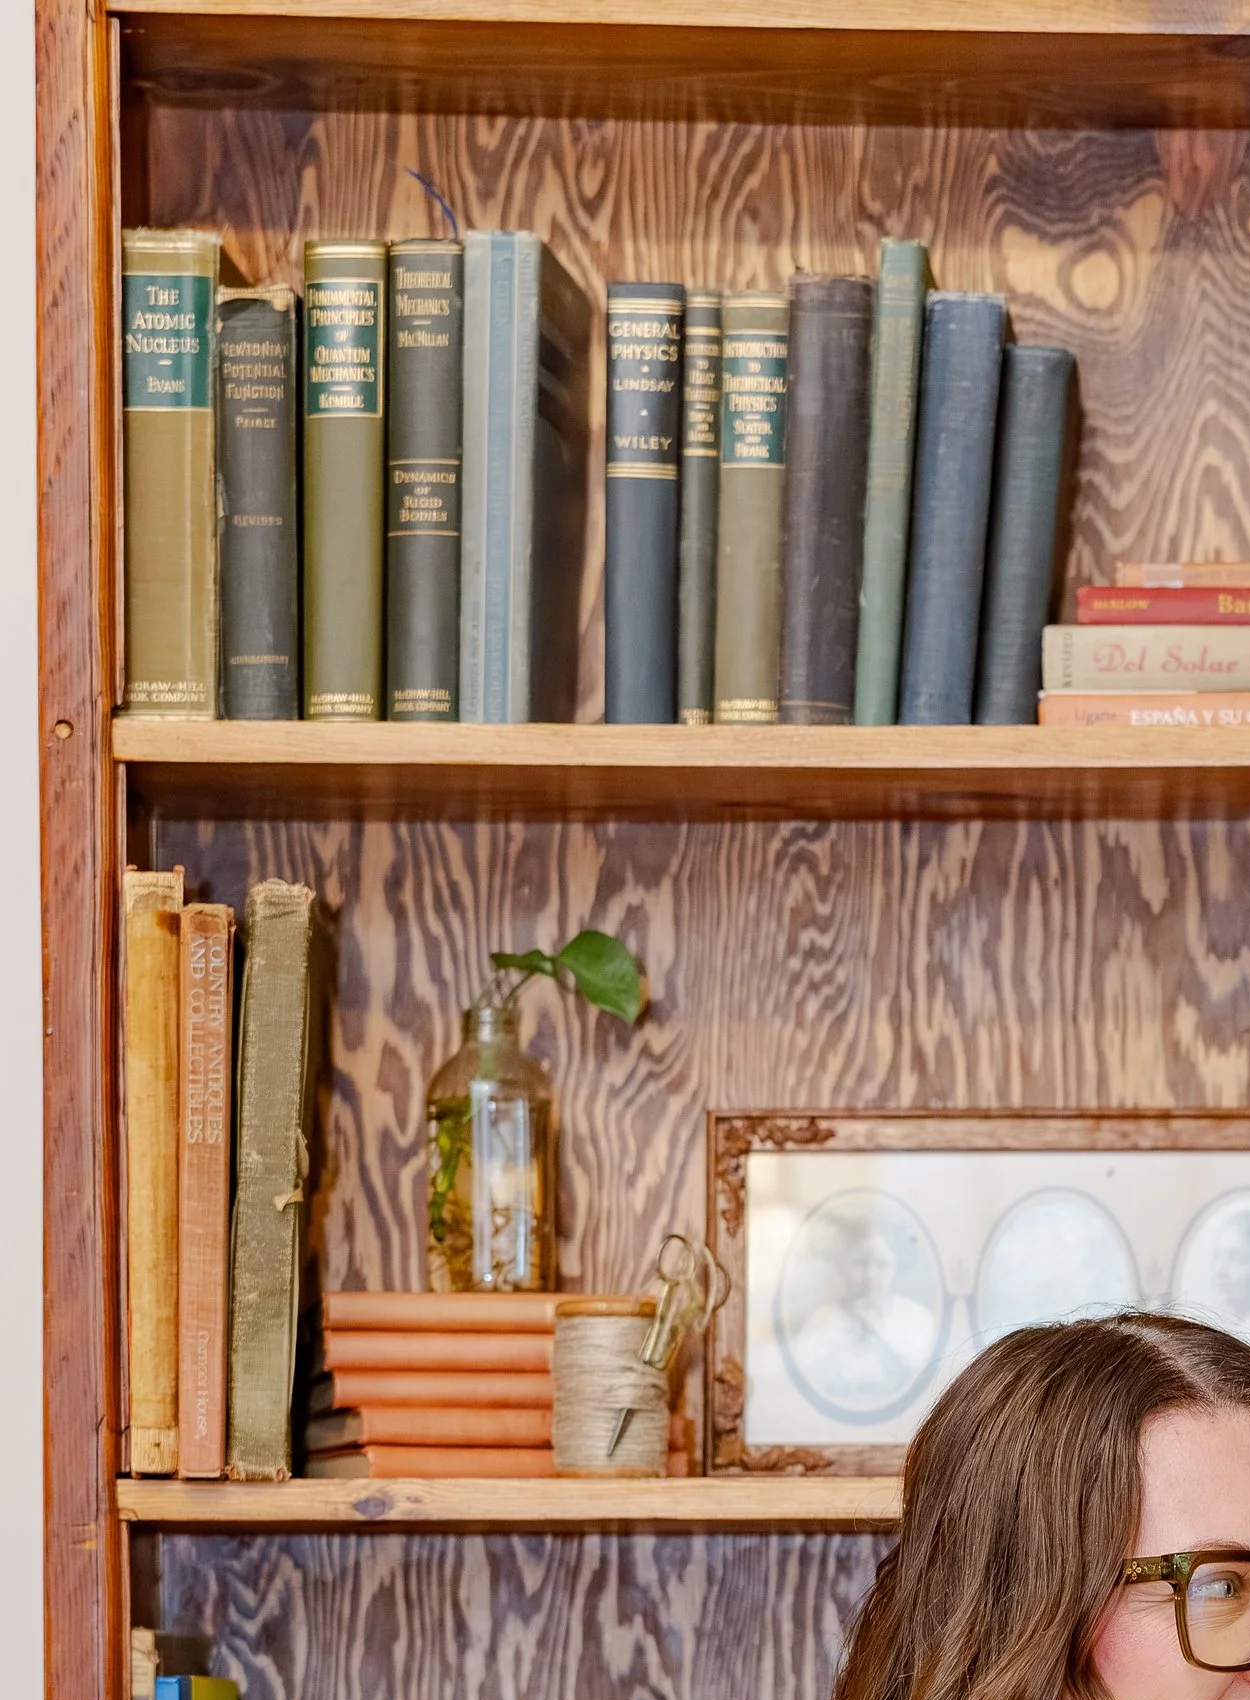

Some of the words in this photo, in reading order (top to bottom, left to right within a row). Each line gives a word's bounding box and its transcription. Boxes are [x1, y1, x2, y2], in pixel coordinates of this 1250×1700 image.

[145, 285, 180, 306] THE
[395, 294, 450, 316] MECHANICS
[131, 311, 195, 330] ATOMIC
[310, 309, 375, 327] PRINCIPLES
[608, 320, 681, 340] GENERAL
[125, 333, 200, 354] NUCLEUS
[611, 343, 679, 361] PHYSICS
[314, 345, 371, 365] QUANTUM
[223, 362, 288, 380] POTENTIAL
[310, 367, 375, 383] MECHANICS
[146, 376, 186, 394] EVANS
[225, 383, 285, 401] FUNCTION
[612, 378, 675, 393] LINDSAY
[319, 392, 365, 408] KEMBLE
[729, 393, 777, 412] PHYSICS
[614, 435, 673, 450] WILEY
[394, 470, 456, 484] DYNAMICS
[403, 495, 442, 510] RIGID
[400, 509, 448, 523] BODIES
[1092, 642, 1147, 673] Del
[1161, 645, 1239, 674] Solar
[151, 691, 208, 703] COMPANY
[1129, 706, 1198, 726] ESPAÑA
[1199, 710, 1215, 724] Y
[1218, 709, 1243, 724] SU
[190, 938, 207, 980] AND
[208, 933, 228, 1033] COUNTRY
[187, 987, 206, 1144] COLLECTIBLES
[206, 1042, 226, 1145] ANTIQUES
